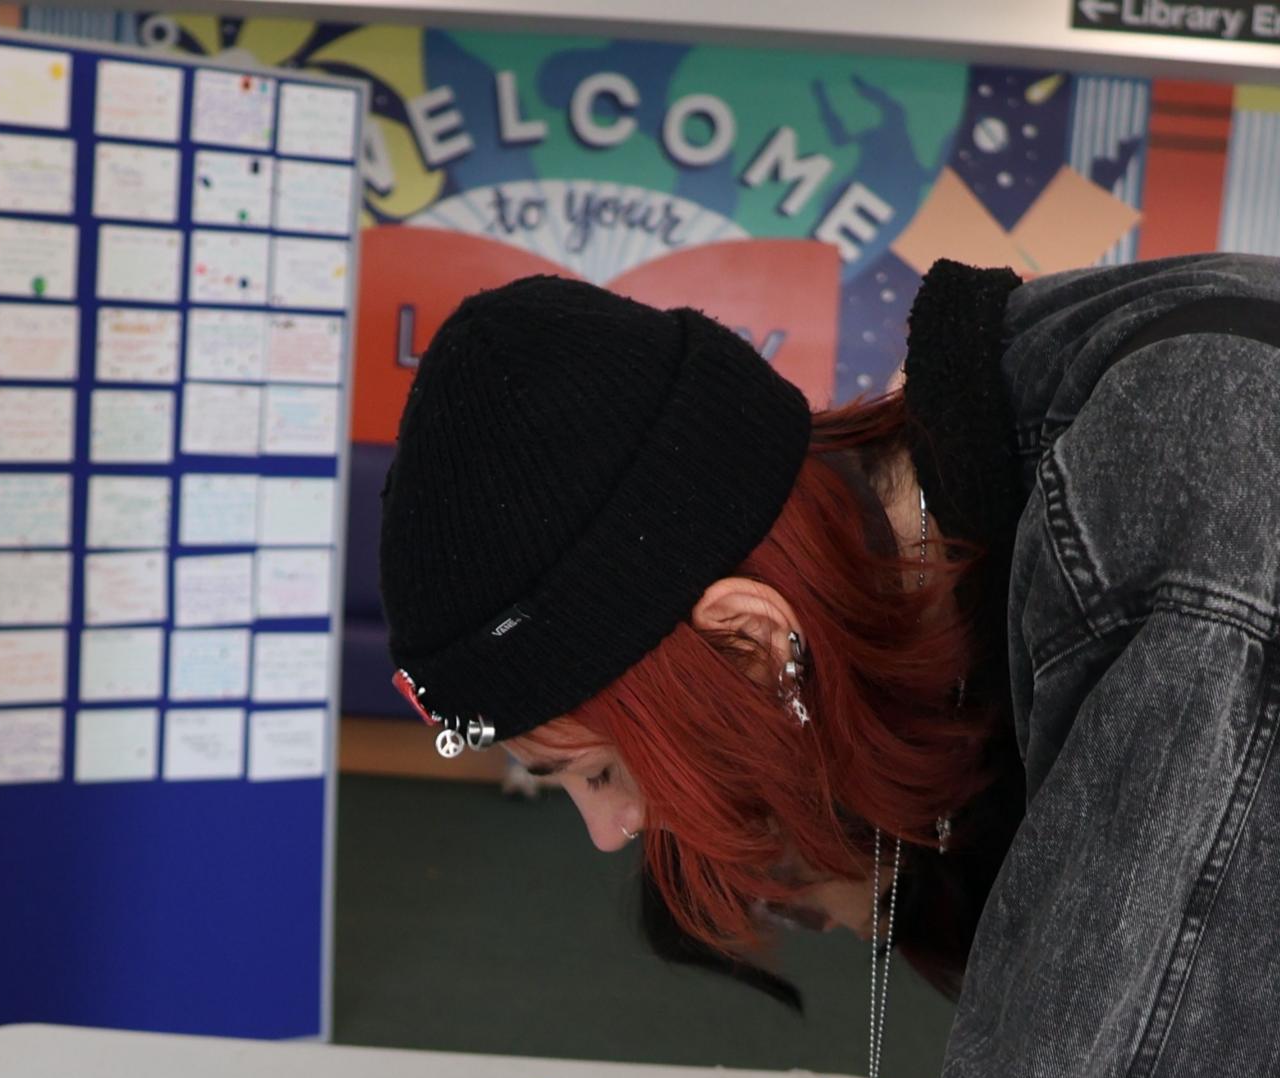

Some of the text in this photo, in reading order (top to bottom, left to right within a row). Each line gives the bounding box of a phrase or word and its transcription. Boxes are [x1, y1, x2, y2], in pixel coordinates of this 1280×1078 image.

[1120, 0, 1243, 40] Library
[487, 186, 686, 252] to your
[492, 616, 521, 637] VANS
